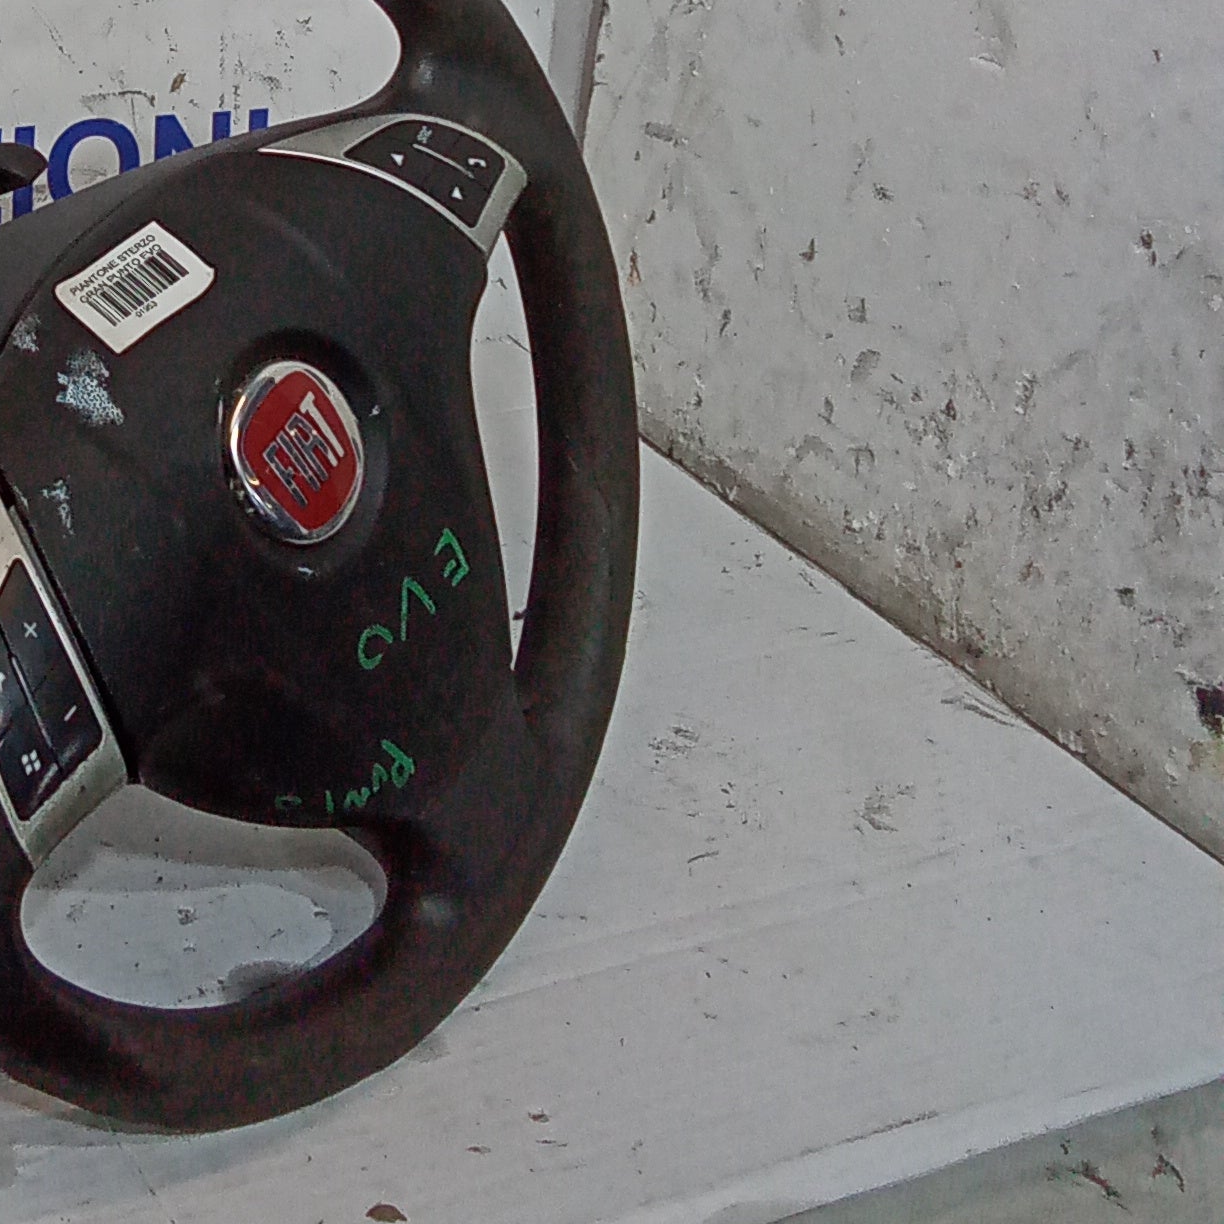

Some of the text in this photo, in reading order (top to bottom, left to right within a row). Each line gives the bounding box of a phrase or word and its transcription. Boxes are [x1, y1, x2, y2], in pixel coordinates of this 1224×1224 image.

[69, 234, 156, 297] PIANTONE STERZO
[79, 282, 109, 305] GRAN
[107, 258, 142, 287] PUNTO
[262, 390, 345, 509] FIAT
[357, 527, 470, 671] EVO
